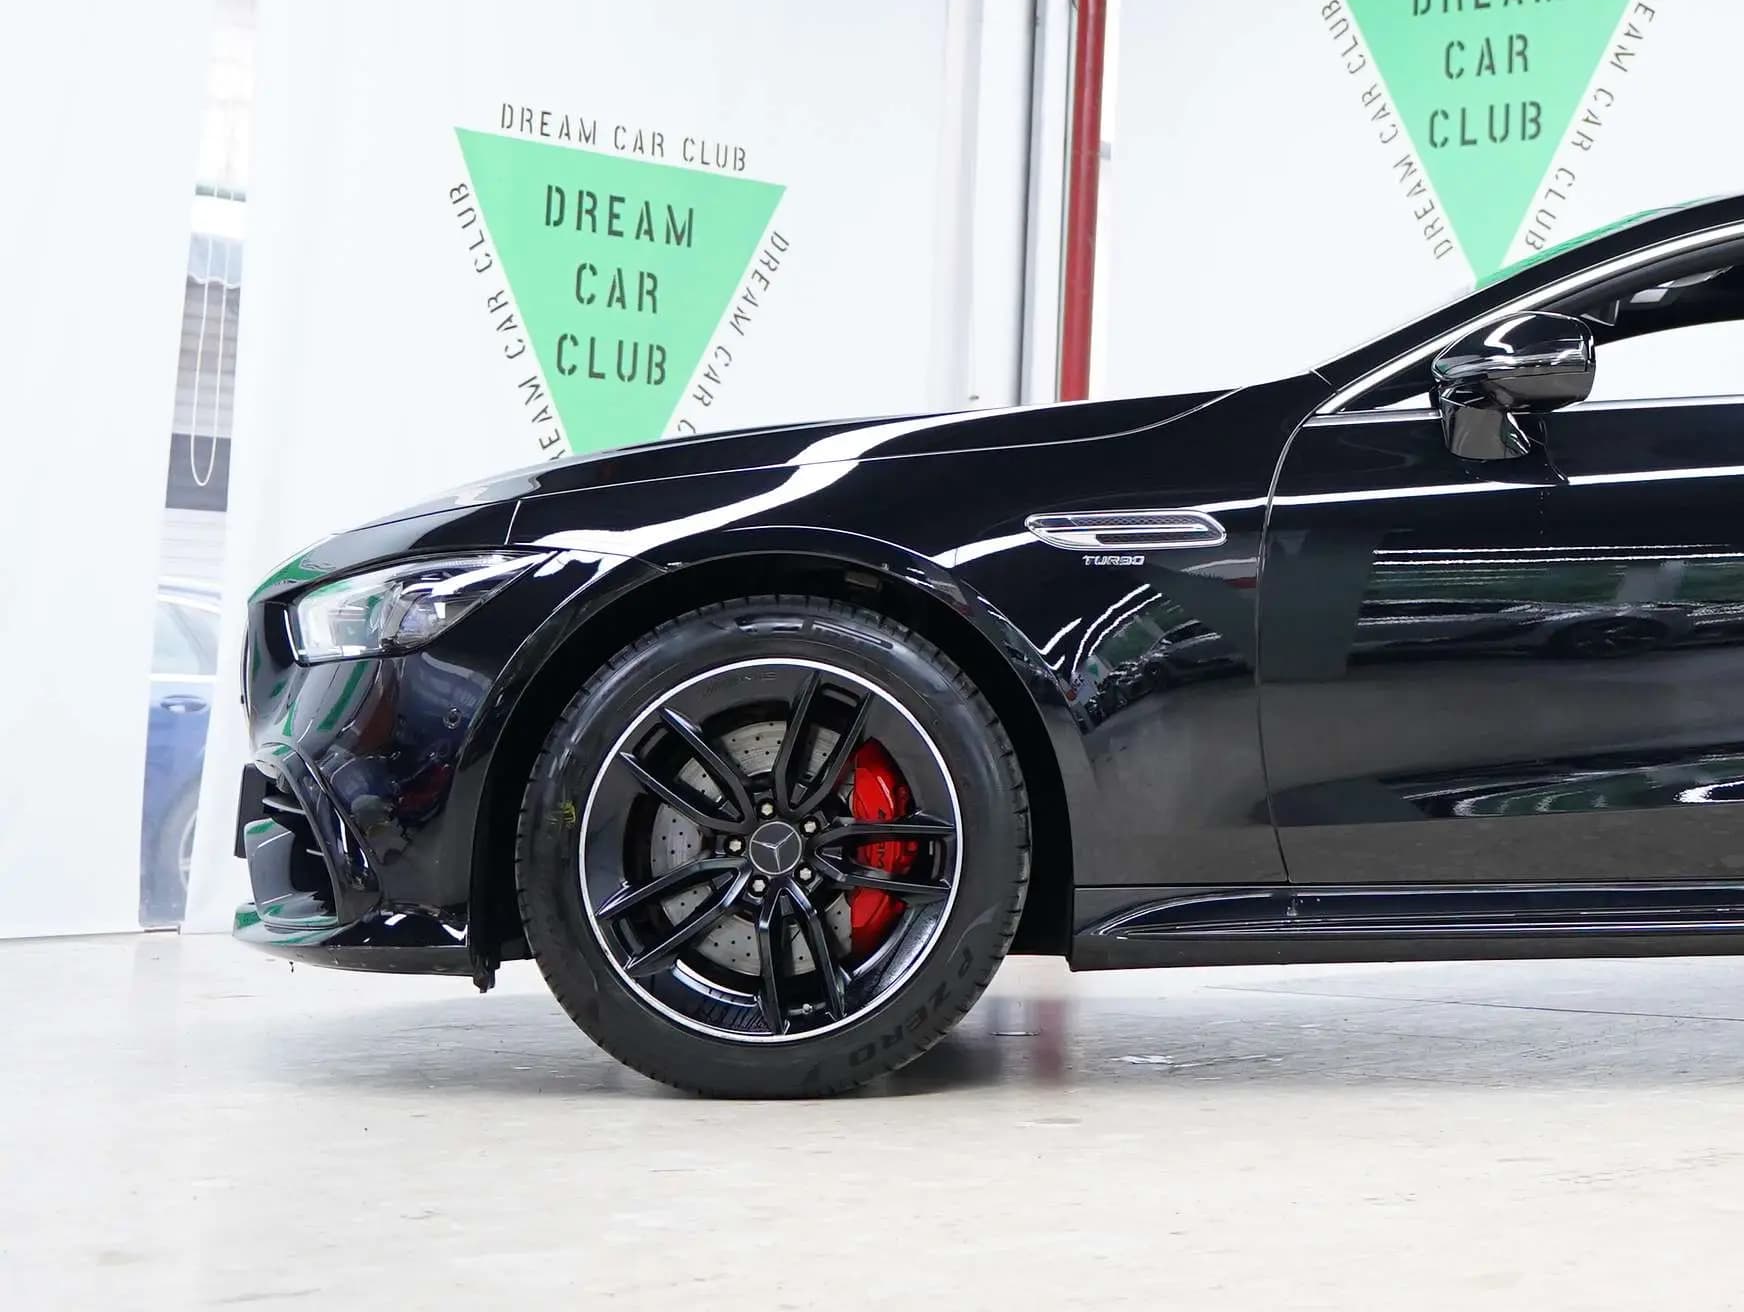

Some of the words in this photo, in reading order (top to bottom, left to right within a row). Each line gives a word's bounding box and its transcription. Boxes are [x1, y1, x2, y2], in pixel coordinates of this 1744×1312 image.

[1444, 33, 1530, 80] CAR
[500, 102, 597, 146] DREAM
[614, 125, 664, 158] CAR
[682, 137, 747, 172] CLUB
[1361, 82, 1399, 145] CAR
[1428, 100, 1543, 149] CLUB
[1571, 87, 1614, 152] CAR
[449, 182, 494, 273] CLUB
[544, 184, 694, 248] DREAM
[1392, 153, 1454, 260] DREAM
[1525, 166, 1576, 250] CLUB
[575, 262, 659, 314] CAR
[729, 230, 790, 336] DREAM
[486, 289, 527, 359] CAR
[556, 333, 668, 386] CLUB
[692, 345, 732, 407] CAR
[518, 375, 565, 461] EAM
[1082, 554, 1146, 566] TURBO
